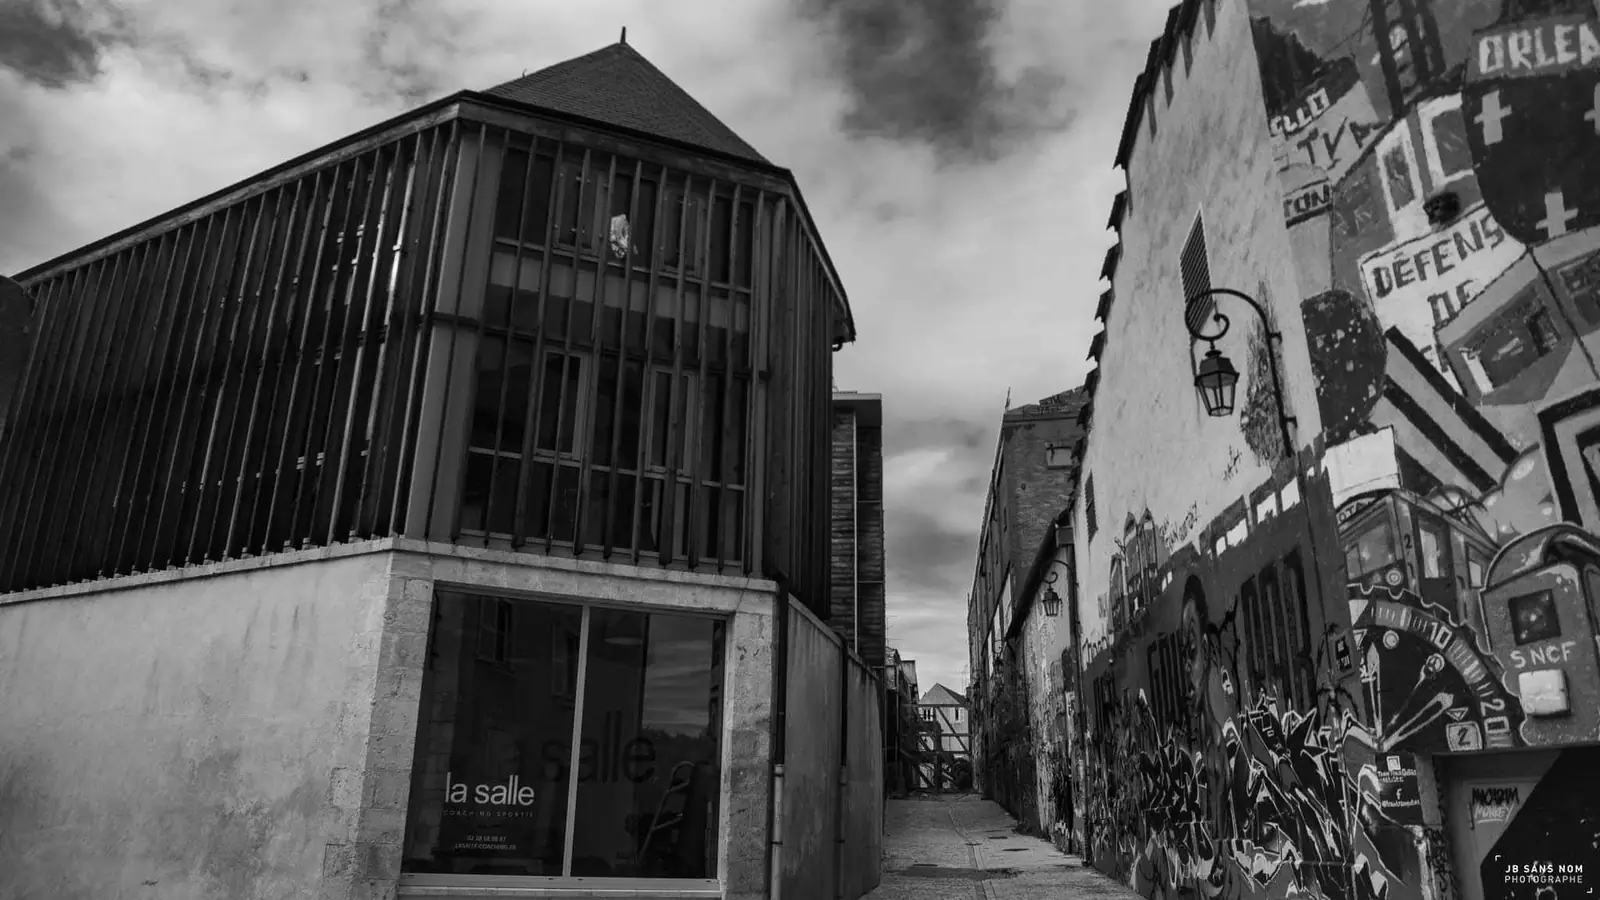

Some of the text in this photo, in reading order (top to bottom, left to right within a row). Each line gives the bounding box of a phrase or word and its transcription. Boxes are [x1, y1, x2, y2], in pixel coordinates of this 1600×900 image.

[1430, 622, 1452, 649] 10
[445, 772, 535, 806] la salle
